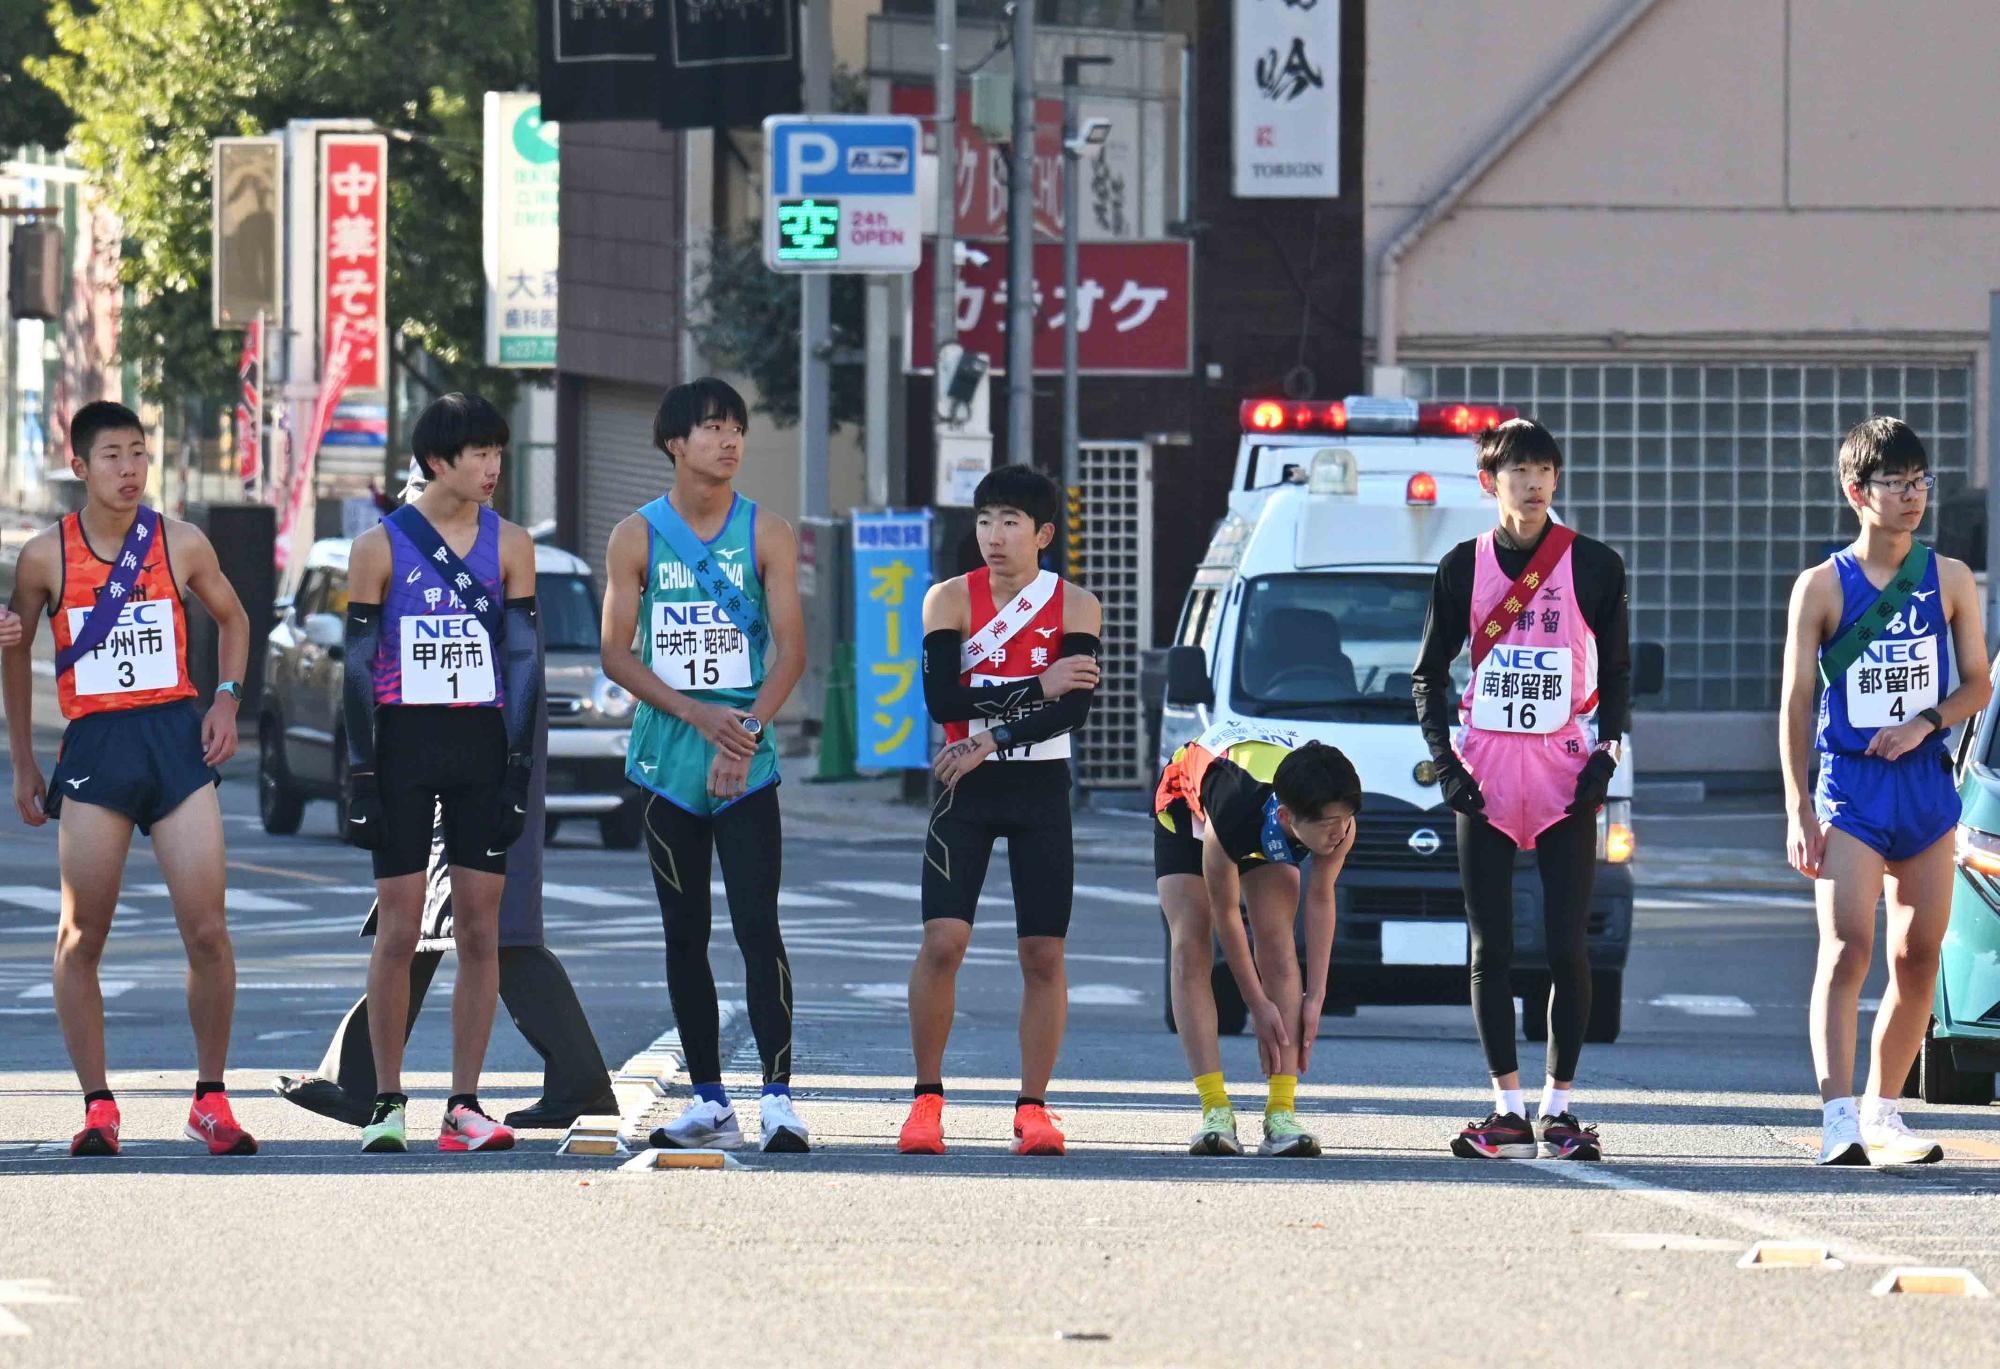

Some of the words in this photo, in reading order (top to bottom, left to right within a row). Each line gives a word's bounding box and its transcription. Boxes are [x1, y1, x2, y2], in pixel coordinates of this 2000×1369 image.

[787, 133, 839, 196] P
[1252, 162, 1323, 178] TORIGIN
[778, 199, 838, 260] 空
[852, 211, 887, 227] 24h
[852, 230, 904, 246] OPEN
[109, 523, 149, 599] 甲州市
[433, 546, 490, 613] 甲府市
[664, 605, 735, 626] NEC
[1472, 571, 1540, 638] 南都留
[415, 618, 479, 639] NEC
[967, 597, 1033, 658] 甲斐市
[1514, 607, 1561, 633] 都留
[656, 627, 744, 656] 中央市・昭和町
[1861, 640, 1928, 664] NEC
[413, 641, 484, 670] 甲府市
[869, 560, 917, 754] オープン
[988, 646, 1049, 668] 甲斐
[1490, 648, 1558, 670] NEC
[117, 661, 136, 688] 3
[446, 672, 459, 700] 1
[684, 659, 720, 686] 15
[1482, 670, 1563, 701] 南都留郡
[1858, 664, 1930, 694] 都留市
[1502, 701, 1537, 730] 16
[1889, 696, 1906, 722] 4
[1565, 739, 1580, 754] 15
